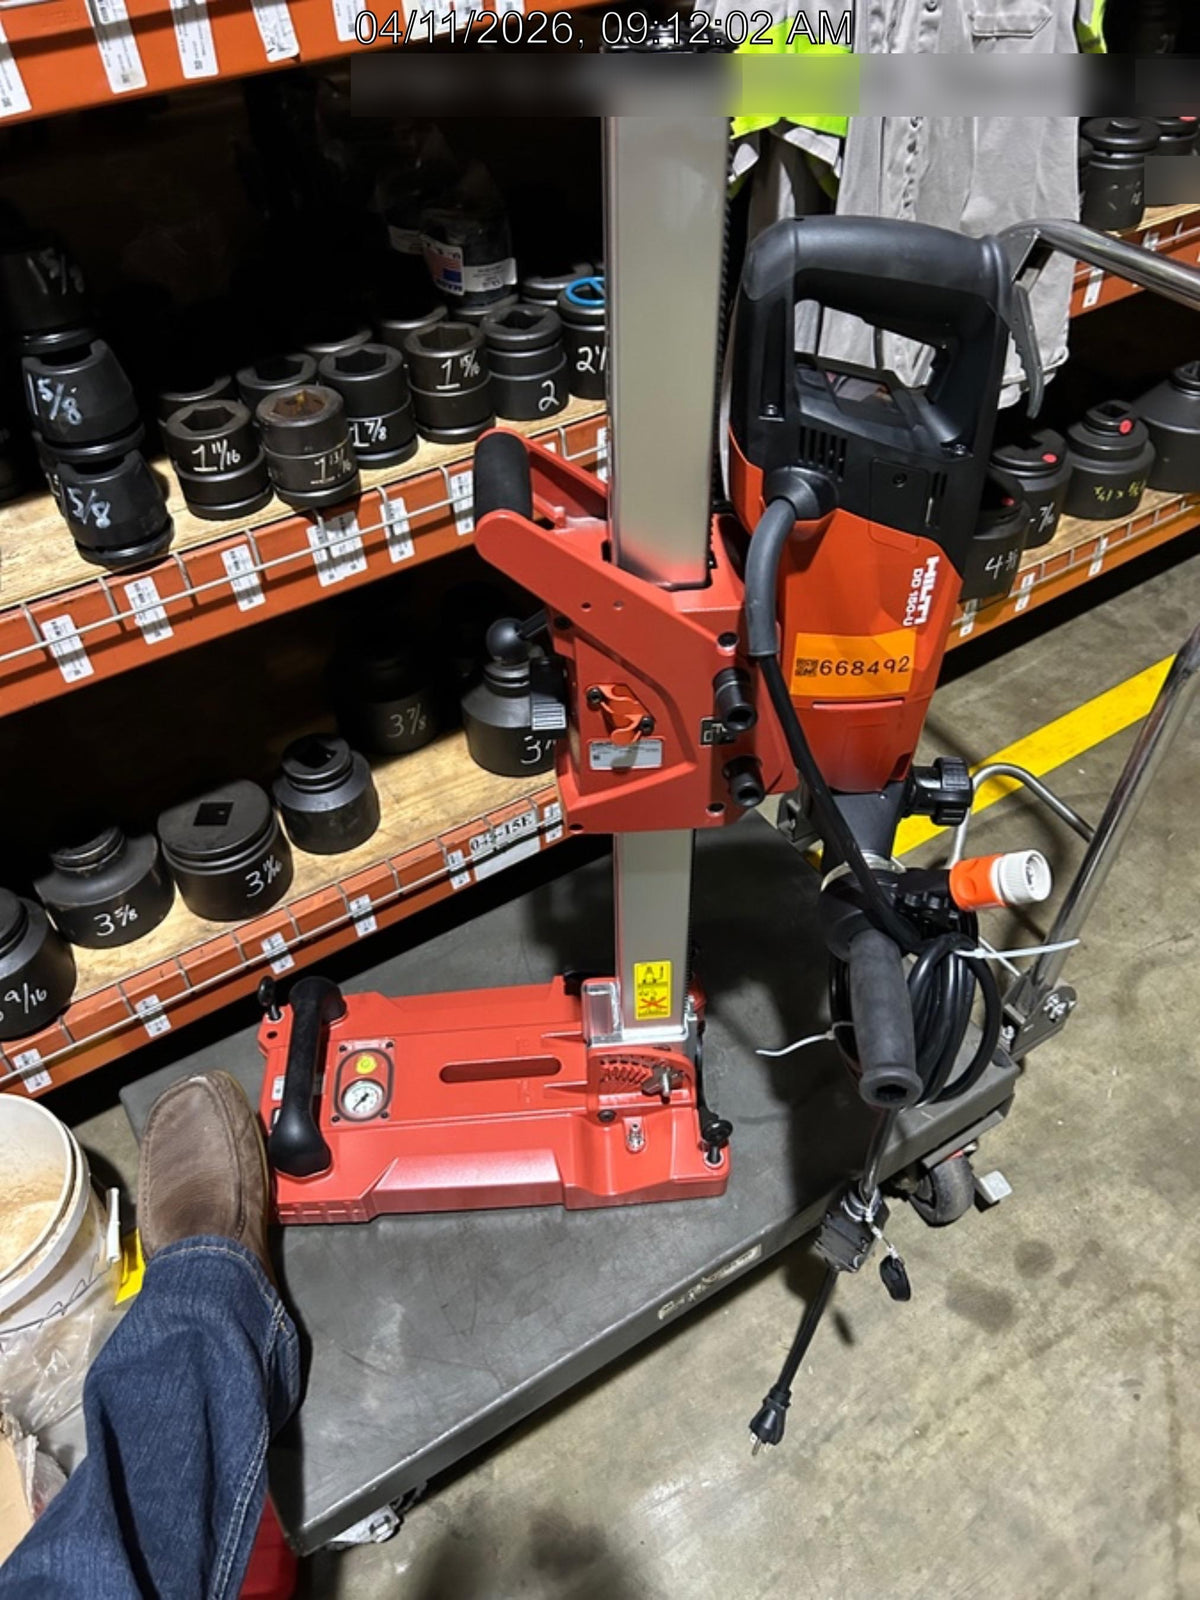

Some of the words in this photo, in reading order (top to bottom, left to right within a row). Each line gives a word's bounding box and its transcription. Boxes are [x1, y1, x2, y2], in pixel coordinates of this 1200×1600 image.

[538, 380, 560, 411] 2
[913, 556, 939, 625] HILTI
[819, 655, 910, 677] 668492
